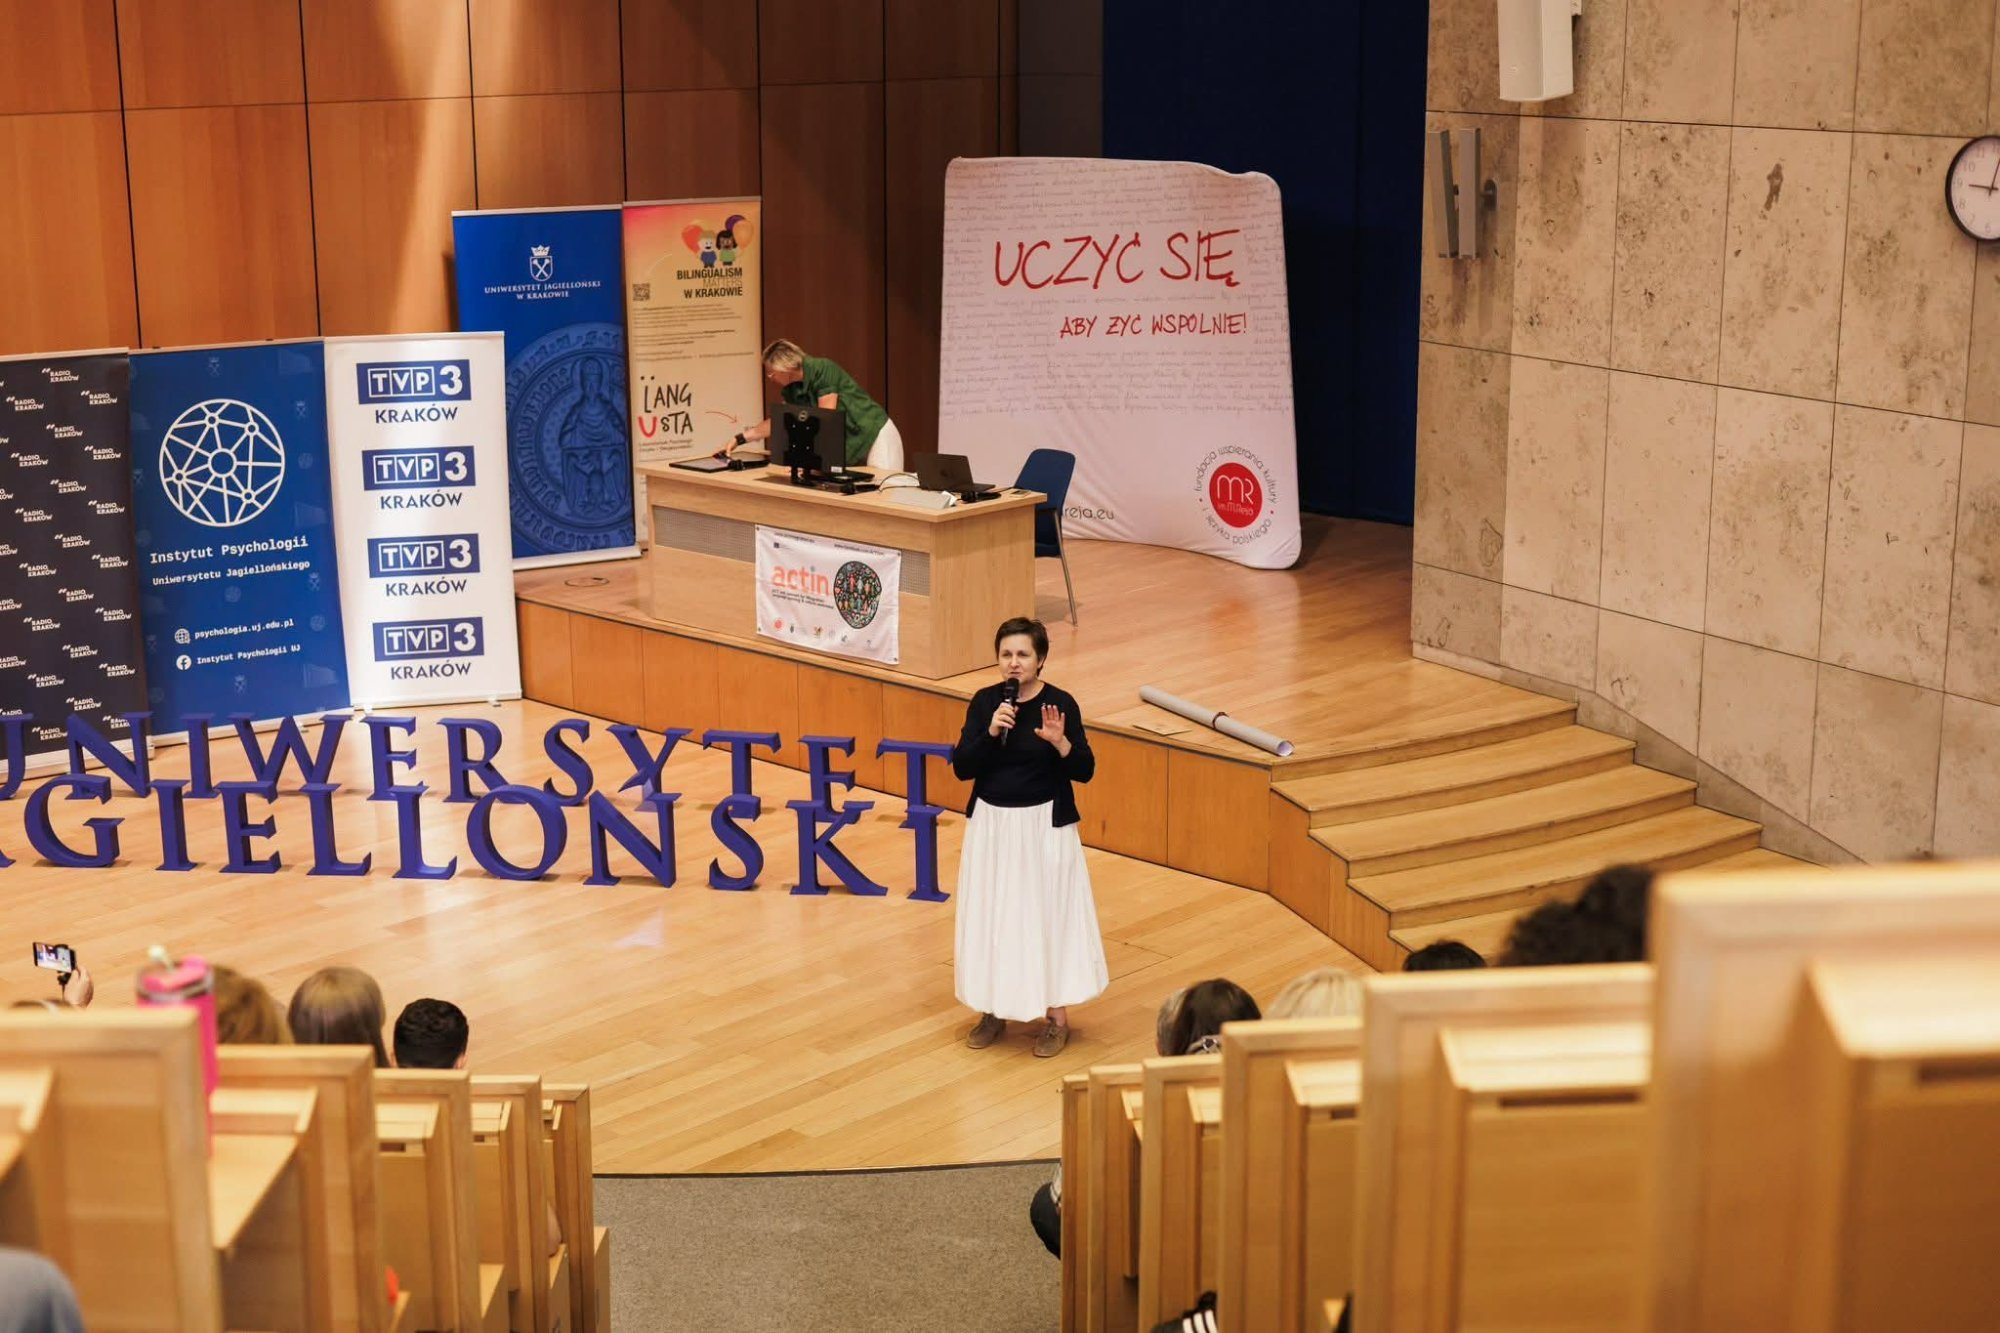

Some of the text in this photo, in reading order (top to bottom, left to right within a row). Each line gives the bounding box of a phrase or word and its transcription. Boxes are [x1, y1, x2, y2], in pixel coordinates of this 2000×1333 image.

[995, 232, 1143, 289] UCZYĆ
[1159, 229, 1240, 287] SIĘ
[677, 268, 742, 279] BILINGUALISM
[484, 284, 540, 293] UNIWERSYTET
[527, 291, 569, 299] KRAKOWIE
[684, 287, 742, 298] W KRAKOWIE
[1060, 315, 1097, 338] ABY
[375, 403, 458, 423] KRAKÓW
[380, 489, 462, 509] KRAKÓW
[24, 509, 44, 517] RADIO
[150, 535, 308, 564] Instytut Psychologii
[152, 561, 310, 586] Uniwersytetu Jagiellońskiego
[771, 565, 830, 596] actin
[385, 577, 467, 597] KRAKÓW
[104, 608, 124, 616] RADIO
[195, 618, 294, 640] psychologia.uj.edu.pl
[71, 645, 91, 653] RADIO
[197, 644, 301, 664] Instytut Psychologii UJ
[391, 660, 471, 680] KRAKÓW
